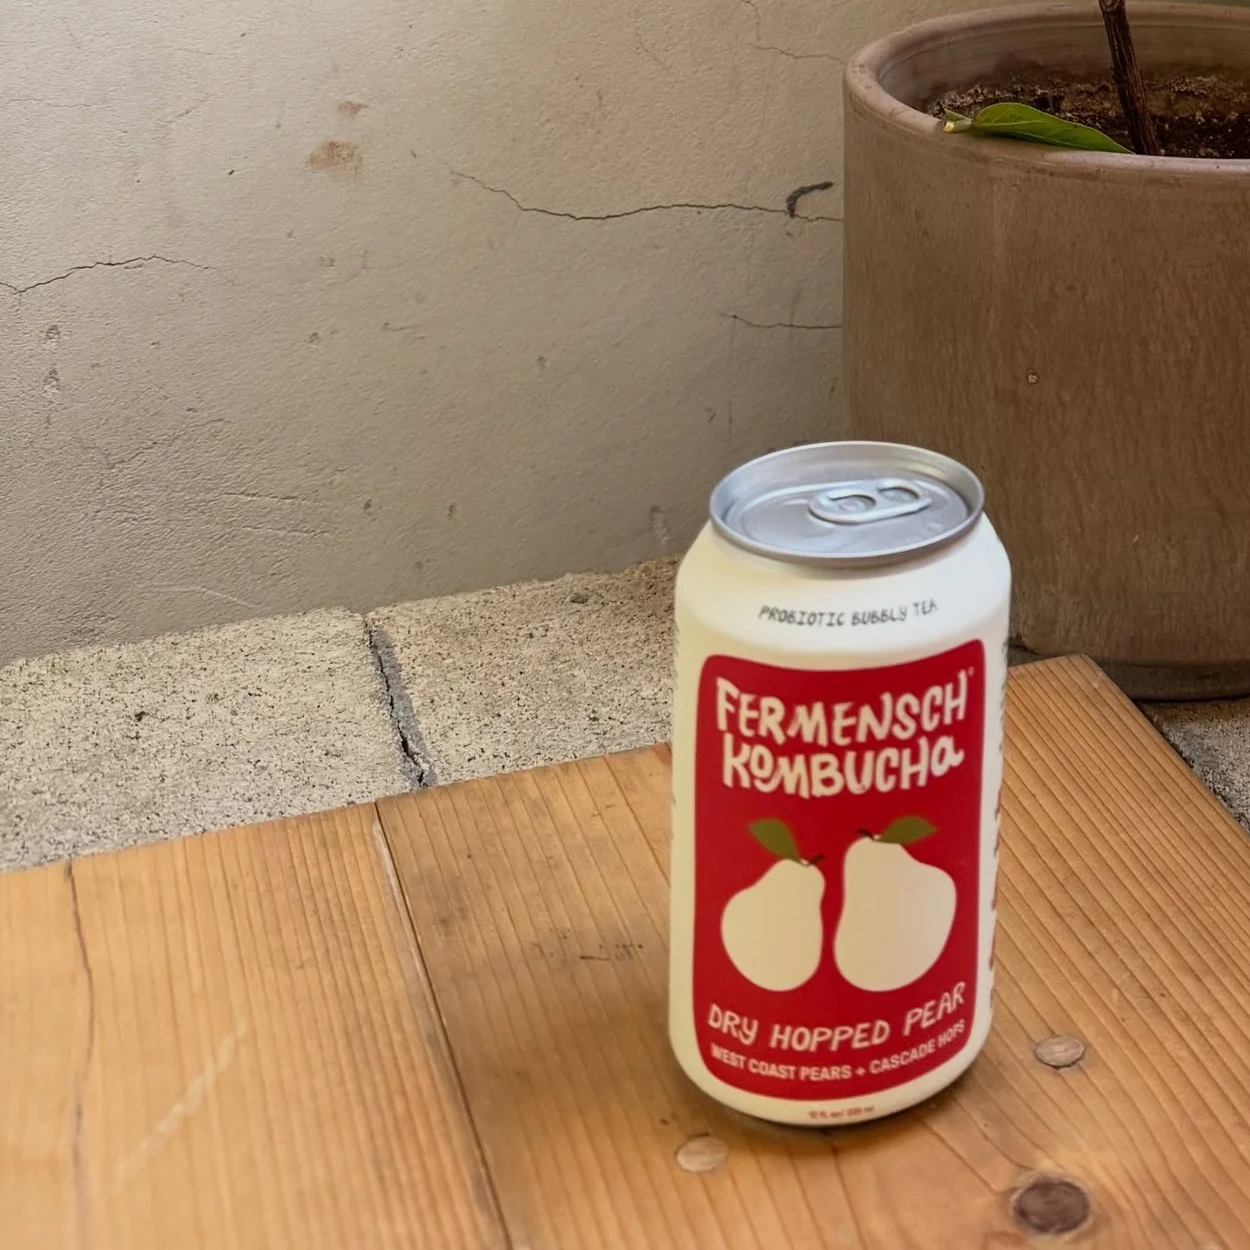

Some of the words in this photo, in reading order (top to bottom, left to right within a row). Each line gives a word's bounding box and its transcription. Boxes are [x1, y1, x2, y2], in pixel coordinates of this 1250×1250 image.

[758, 605, 845, 627] PROBIOTIC
[851, 605, 908, 626] BUBBLY
[913, 598, 938, 616] TEA
[716, 669, 968, 747] FERMENSCH
[708, 1004, 759, 1046] DRY
[769, 1020, 890, 1052] HOPPED
[903, 982, 966, 1036] PEAR
[710, 1043, 746, 1069] WEST
[748, 1056, 795, 1080] COAST
[799, 1064, 852, 1081] PEARS
[869, 1041, 937, 1074] CASCADE
[937, 1018, 966, 1049] HOPS
